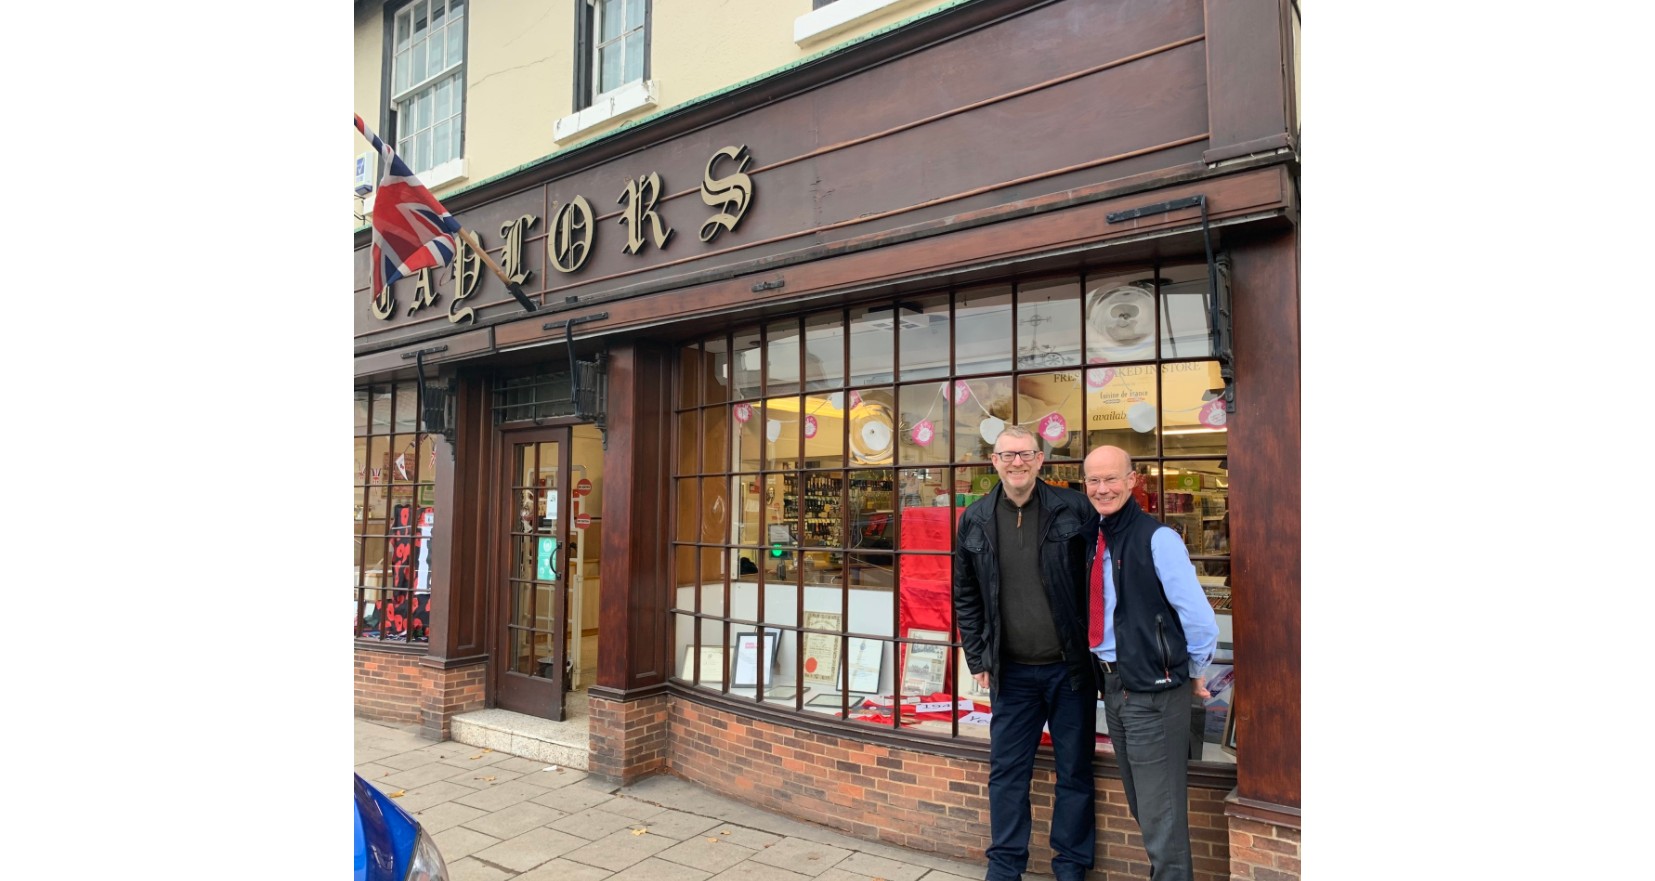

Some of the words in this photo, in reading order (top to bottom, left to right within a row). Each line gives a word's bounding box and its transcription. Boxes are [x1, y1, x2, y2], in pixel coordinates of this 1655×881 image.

[1110, 366, 1143, 378] AKED
[1145, 365, 1157, 375] IN
[1161, 361, 1201, 374] STORE
[1092, 410, 1127, 421] availab
